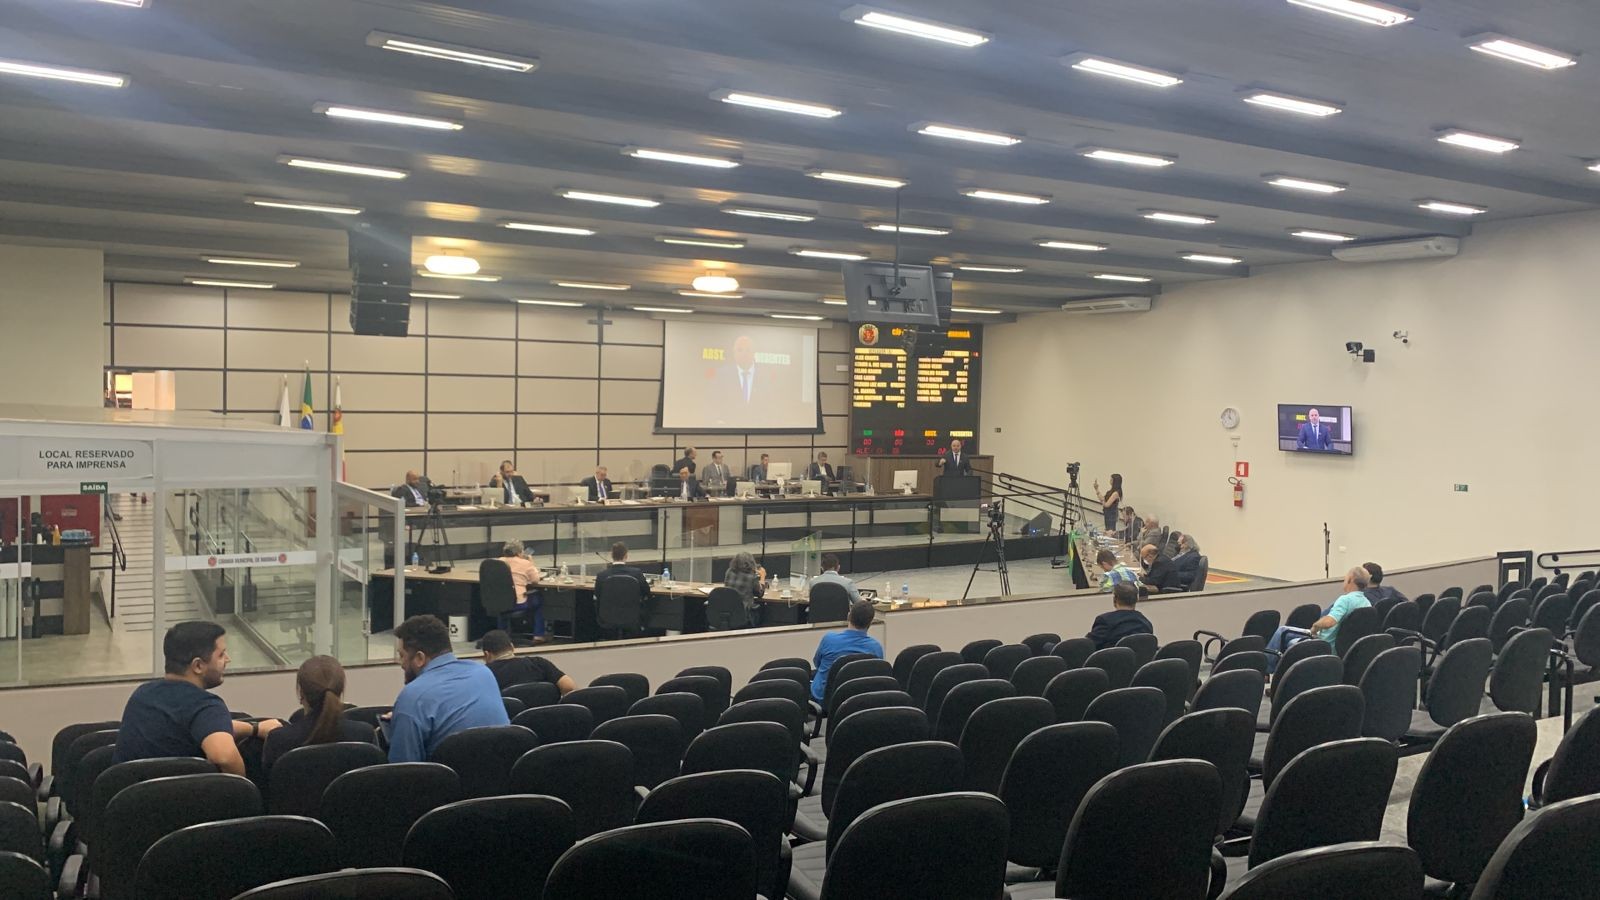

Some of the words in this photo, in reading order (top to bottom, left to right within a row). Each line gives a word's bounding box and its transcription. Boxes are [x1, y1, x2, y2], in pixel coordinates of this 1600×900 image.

[39, 450, 72, 459] LOCAL
[75, 450, 134, 459] RESERVADO
[47, 460, 74, 469] PARA
[76, 460, 126, 469] IMPRENSA
